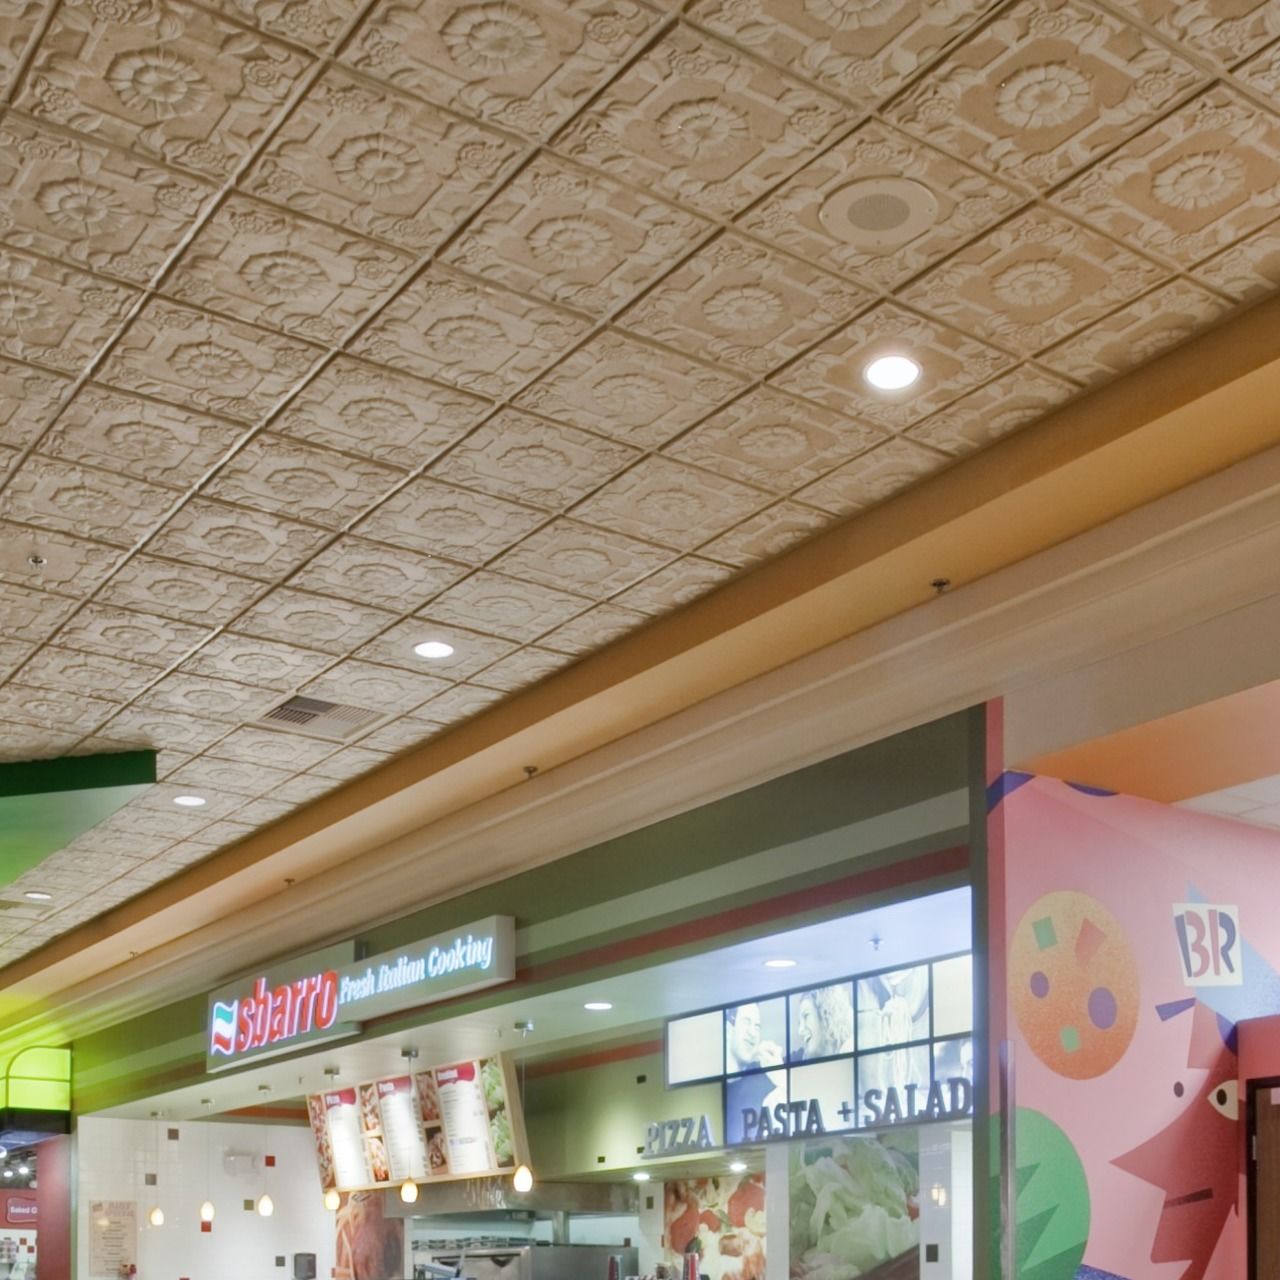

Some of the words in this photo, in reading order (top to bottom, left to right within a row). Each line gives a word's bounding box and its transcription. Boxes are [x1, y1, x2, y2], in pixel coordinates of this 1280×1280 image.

[1173, 908, 1237, 978] BR
[239, 970, 338, 1052] sbarro
[340, 969, 375, 1004] Fresh
[376, 955, 426, 994] Italian
[427, 935, 494, 977] Cooking
[645, 1115, 714, 1153] PIZZA
[742, 1099, 826, 1140] PASTA
[862, 1077, 973, 1127] SALAD
